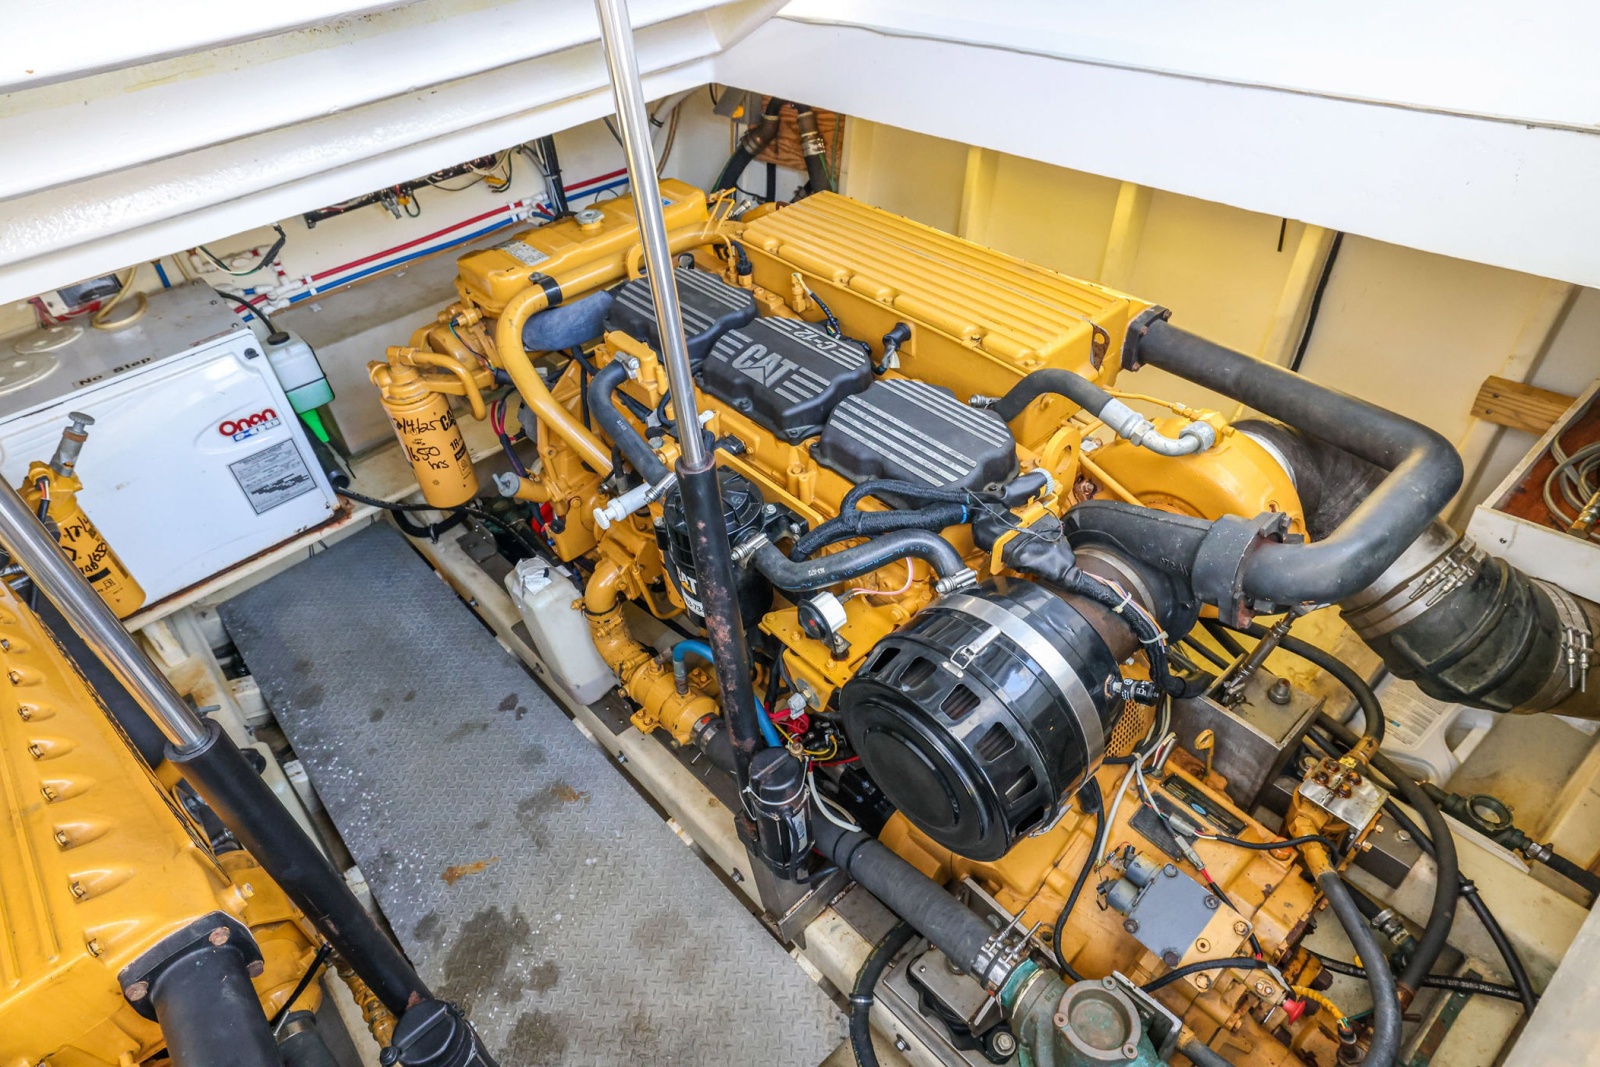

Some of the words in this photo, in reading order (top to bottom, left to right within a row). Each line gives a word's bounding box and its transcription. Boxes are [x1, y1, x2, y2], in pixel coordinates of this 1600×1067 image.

[793, 328, 838, 350] C-12
[79, 375, 103, 386] No
[113, 357, 151, 373] Step
[731, 343, 800, 388] CAT
[218, 408, 277, 436] Onan
[440, 408, 456, 431] CA
